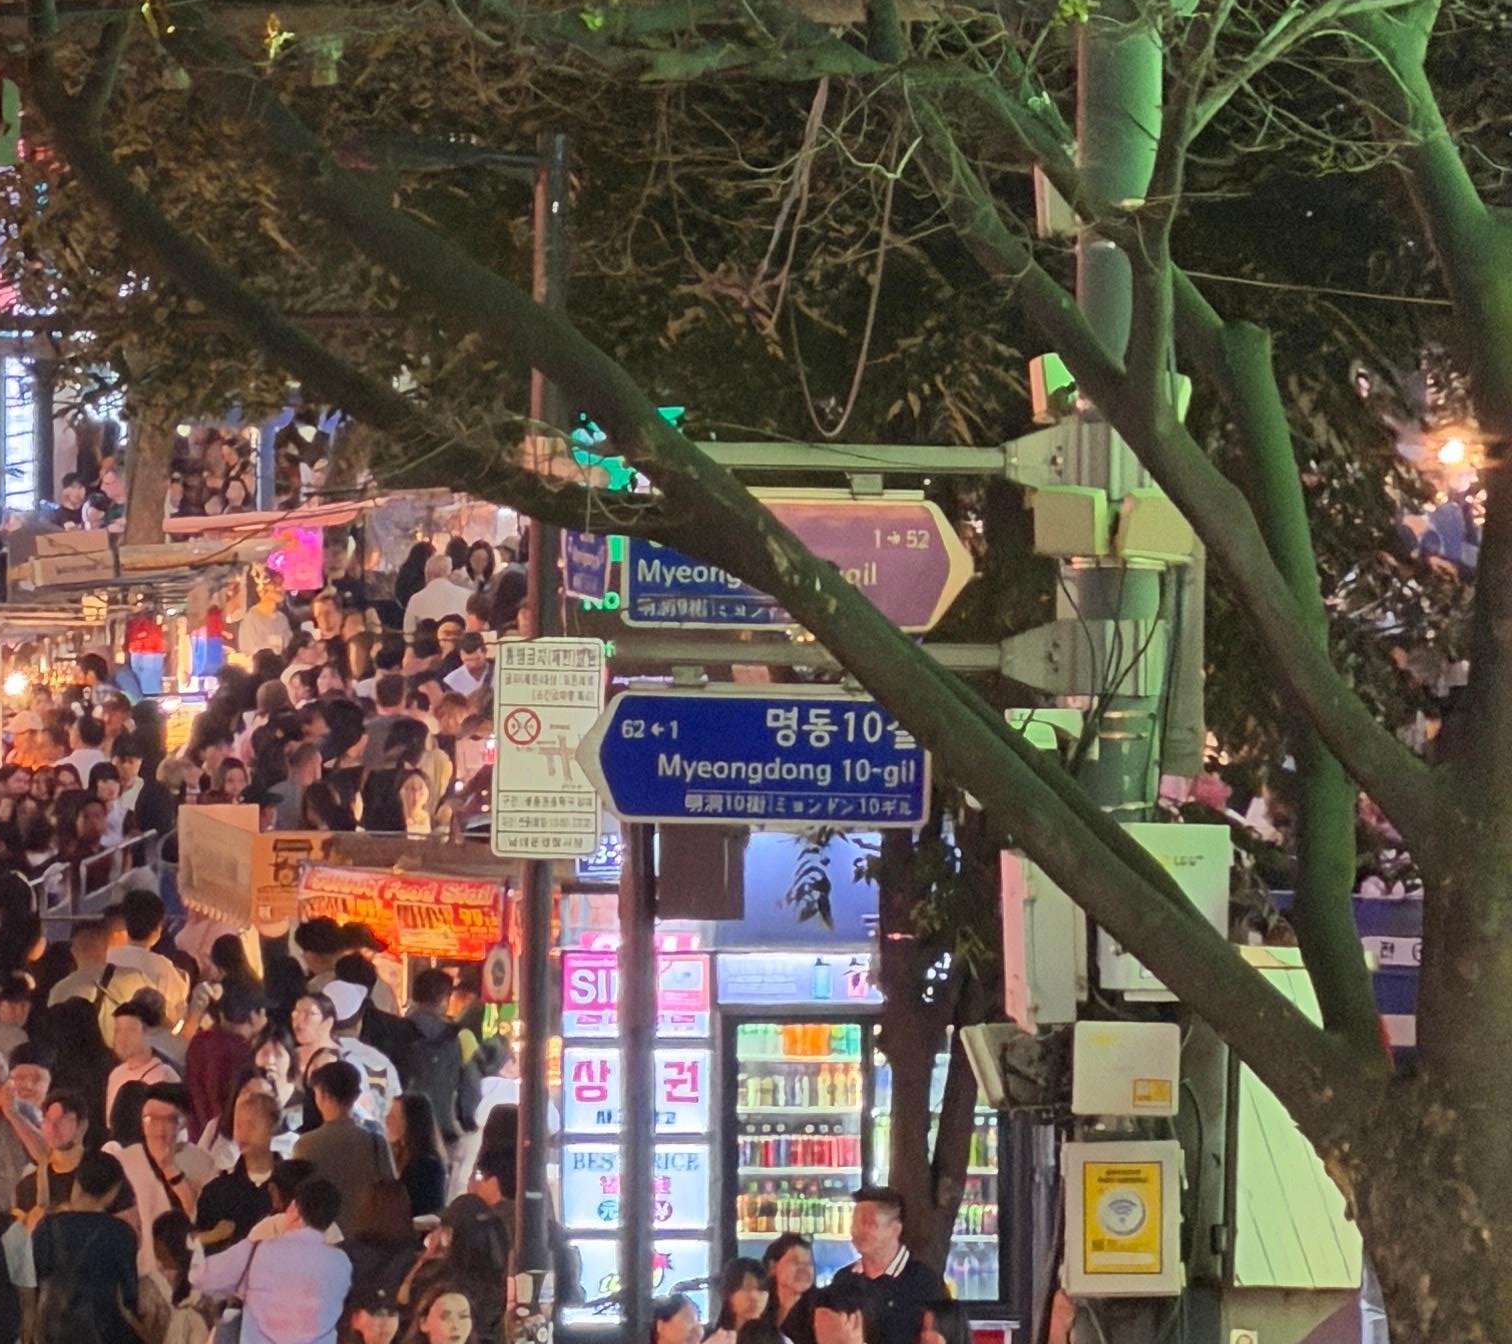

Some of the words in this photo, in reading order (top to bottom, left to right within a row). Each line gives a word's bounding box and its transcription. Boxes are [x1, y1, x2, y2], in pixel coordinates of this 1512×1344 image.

[638, 558, 744, 589] Myeong
[621, 719, 645, 739] 62
[657, 754, 832, 786] Myeongdong
[842, 759, 915, 787] 10-gil
[572, 1059, 700, 1103] 상권
[573, 1152, 614, 1171] BES
[653, 1152, 700, 1172] RICE
